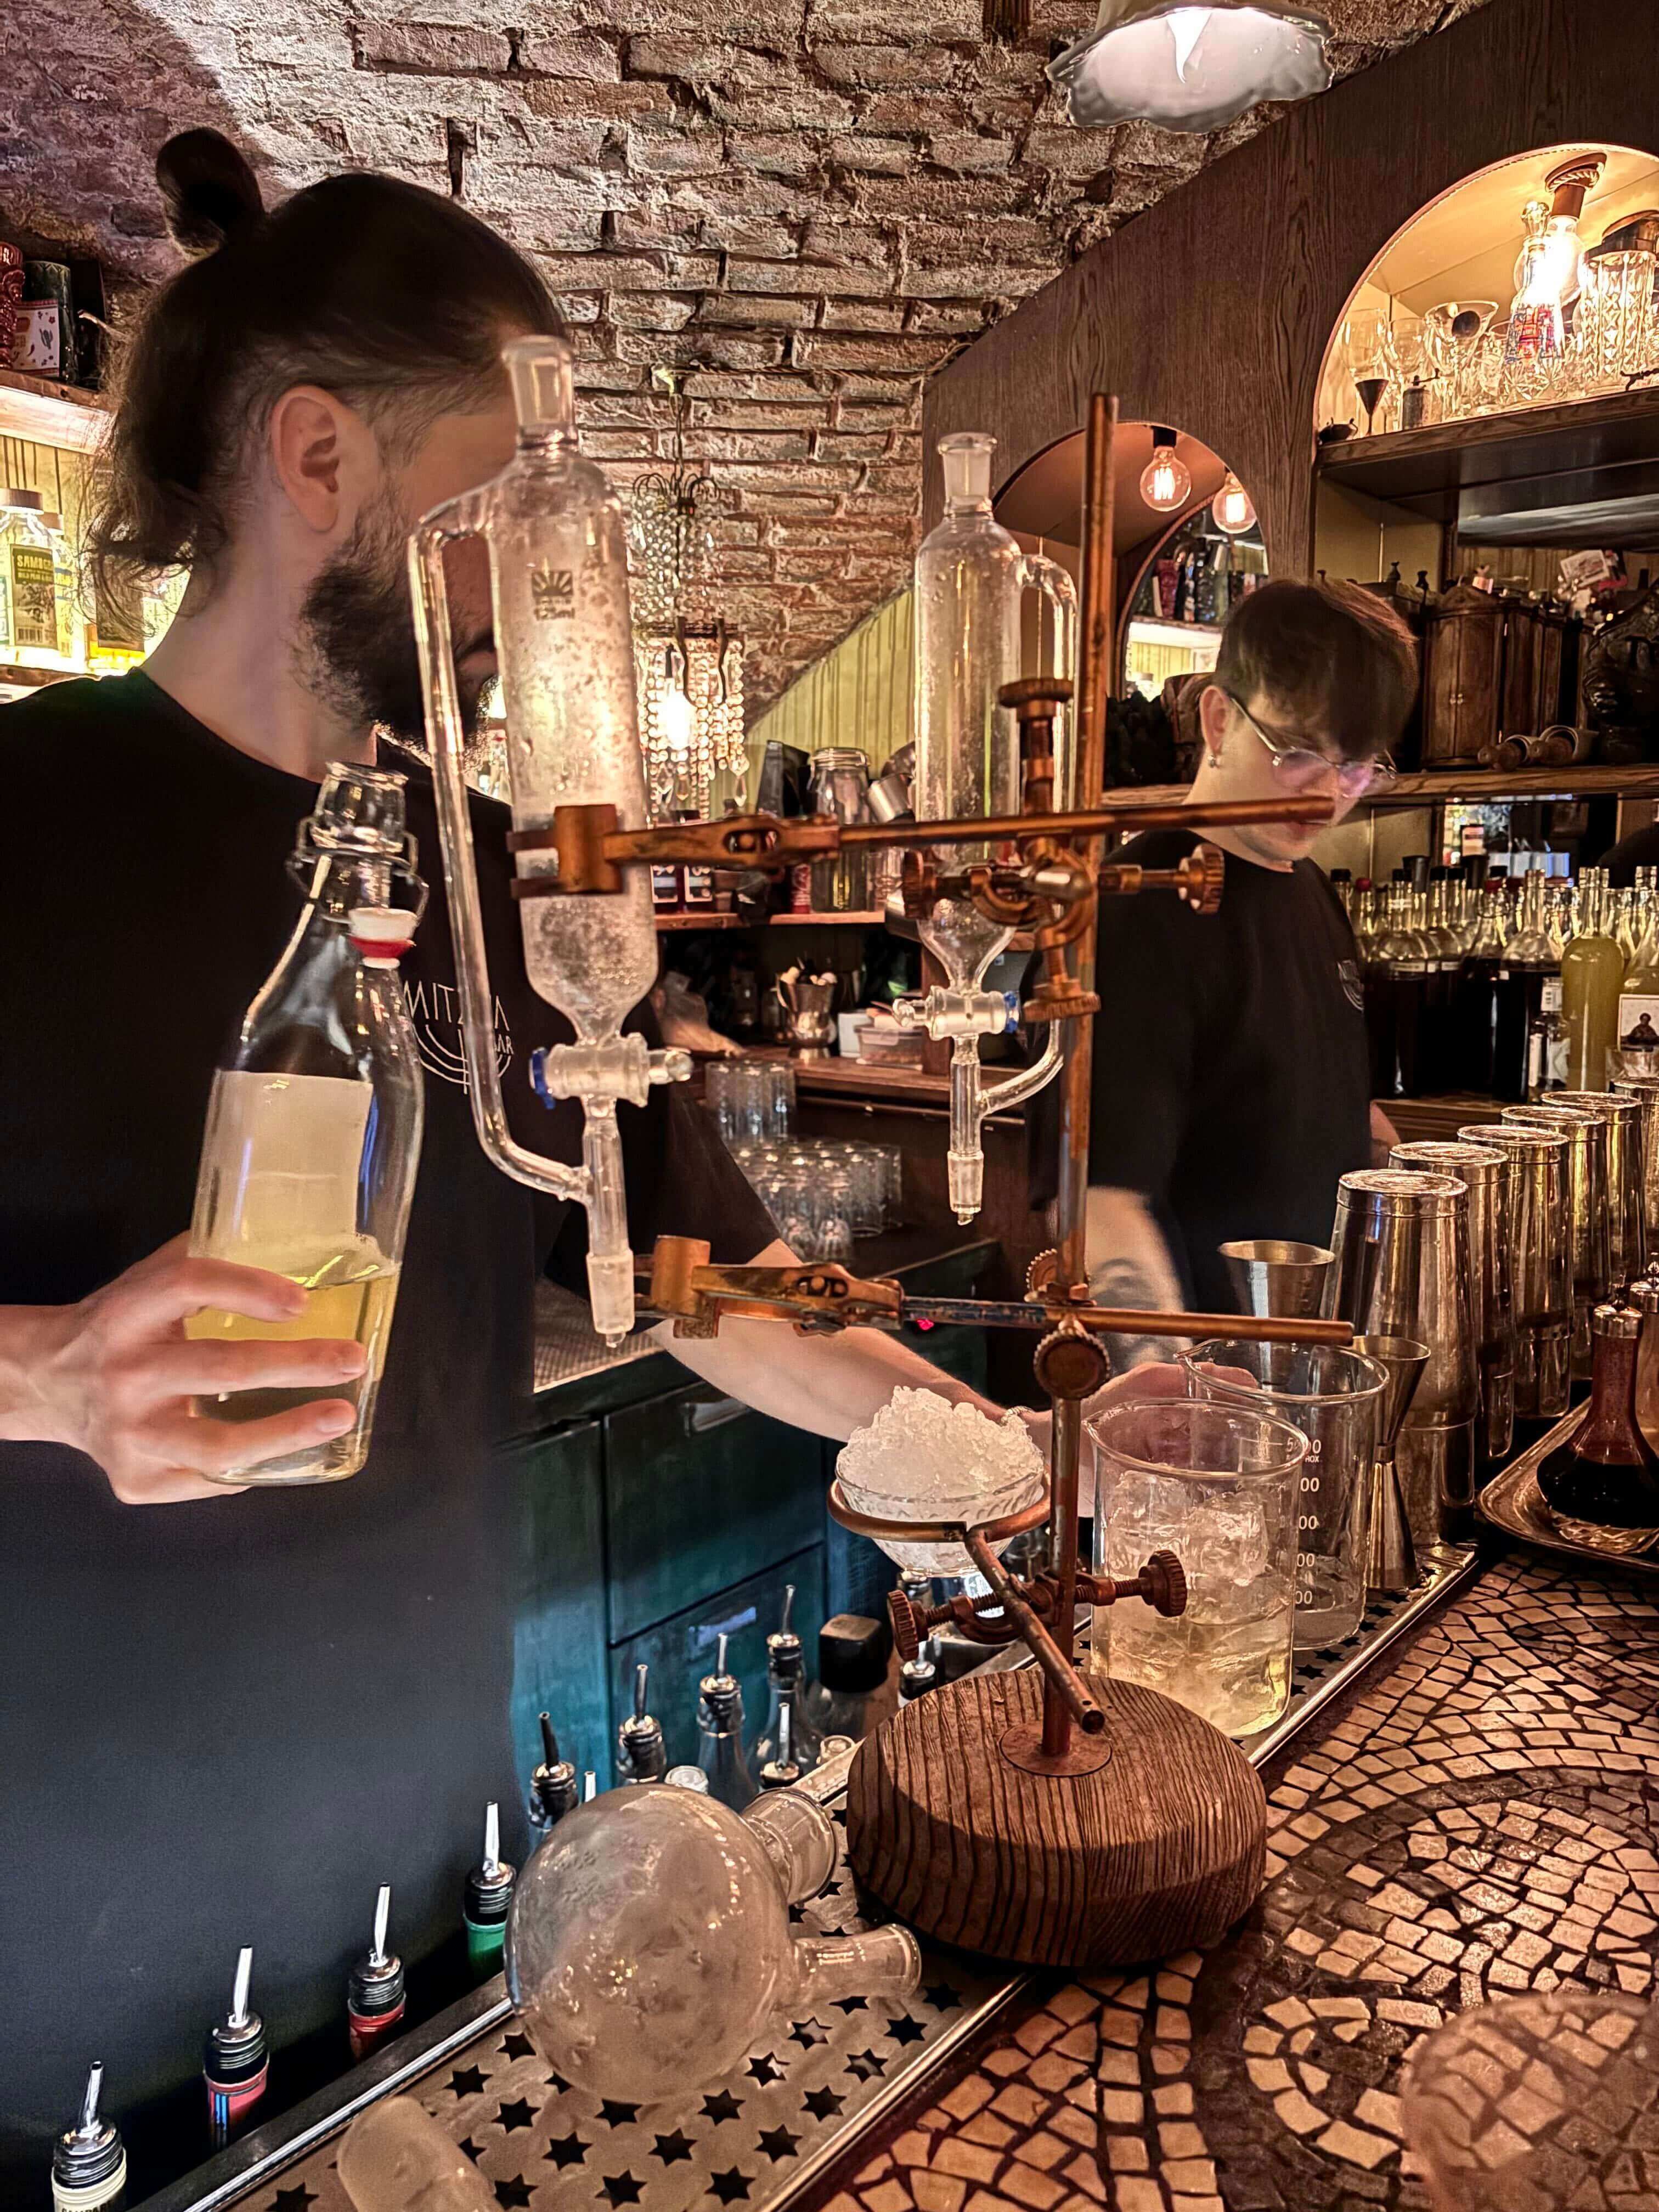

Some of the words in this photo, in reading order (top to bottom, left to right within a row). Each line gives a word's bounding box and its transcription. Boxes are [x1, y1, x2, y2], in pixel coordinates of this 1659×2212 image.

[404, 980, 510, 1031] MITA
[494, 1034, 514, 1055] AR
[1300, 1477, 1320, 1492] 00
[1299, 1515, 1318, 1530] 00
[1297, 1553, 1315, 1567] 00
[1295, 1590, 1313, 1605] 00
